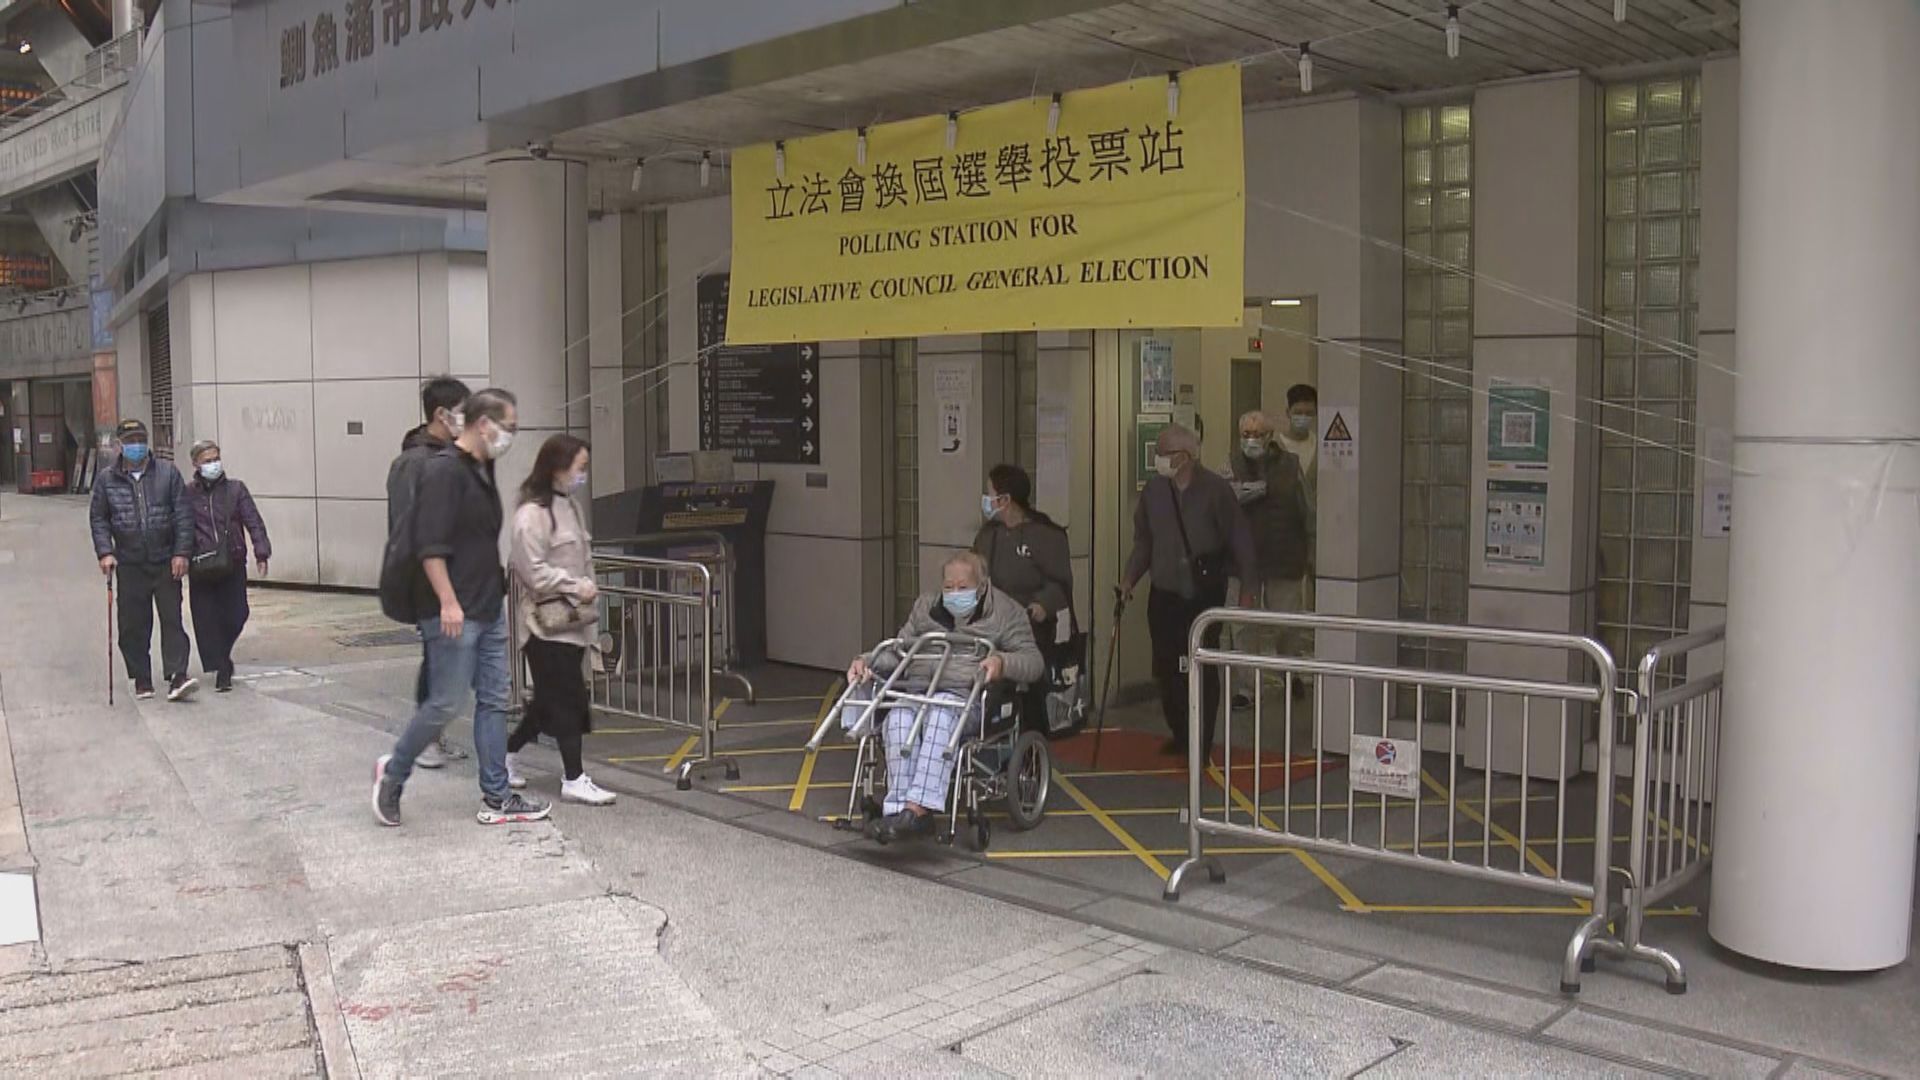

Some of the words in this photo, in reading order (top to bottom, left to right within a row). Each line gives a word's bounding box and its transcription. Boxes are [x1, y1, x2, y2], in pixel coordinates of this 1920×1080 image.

[838, 228, 921, 256] POLLING
[929, 217, 1019, 248] STATION
[1030, 213, 1078, 237] FOR
[748, 280, 862, 308] LEGISLATIVE
[870, 273, 954, 299] COUNCIL
[966, 264, 1070, 292] GENERAL
[1080, 254, 1209, 284] ELECTION
